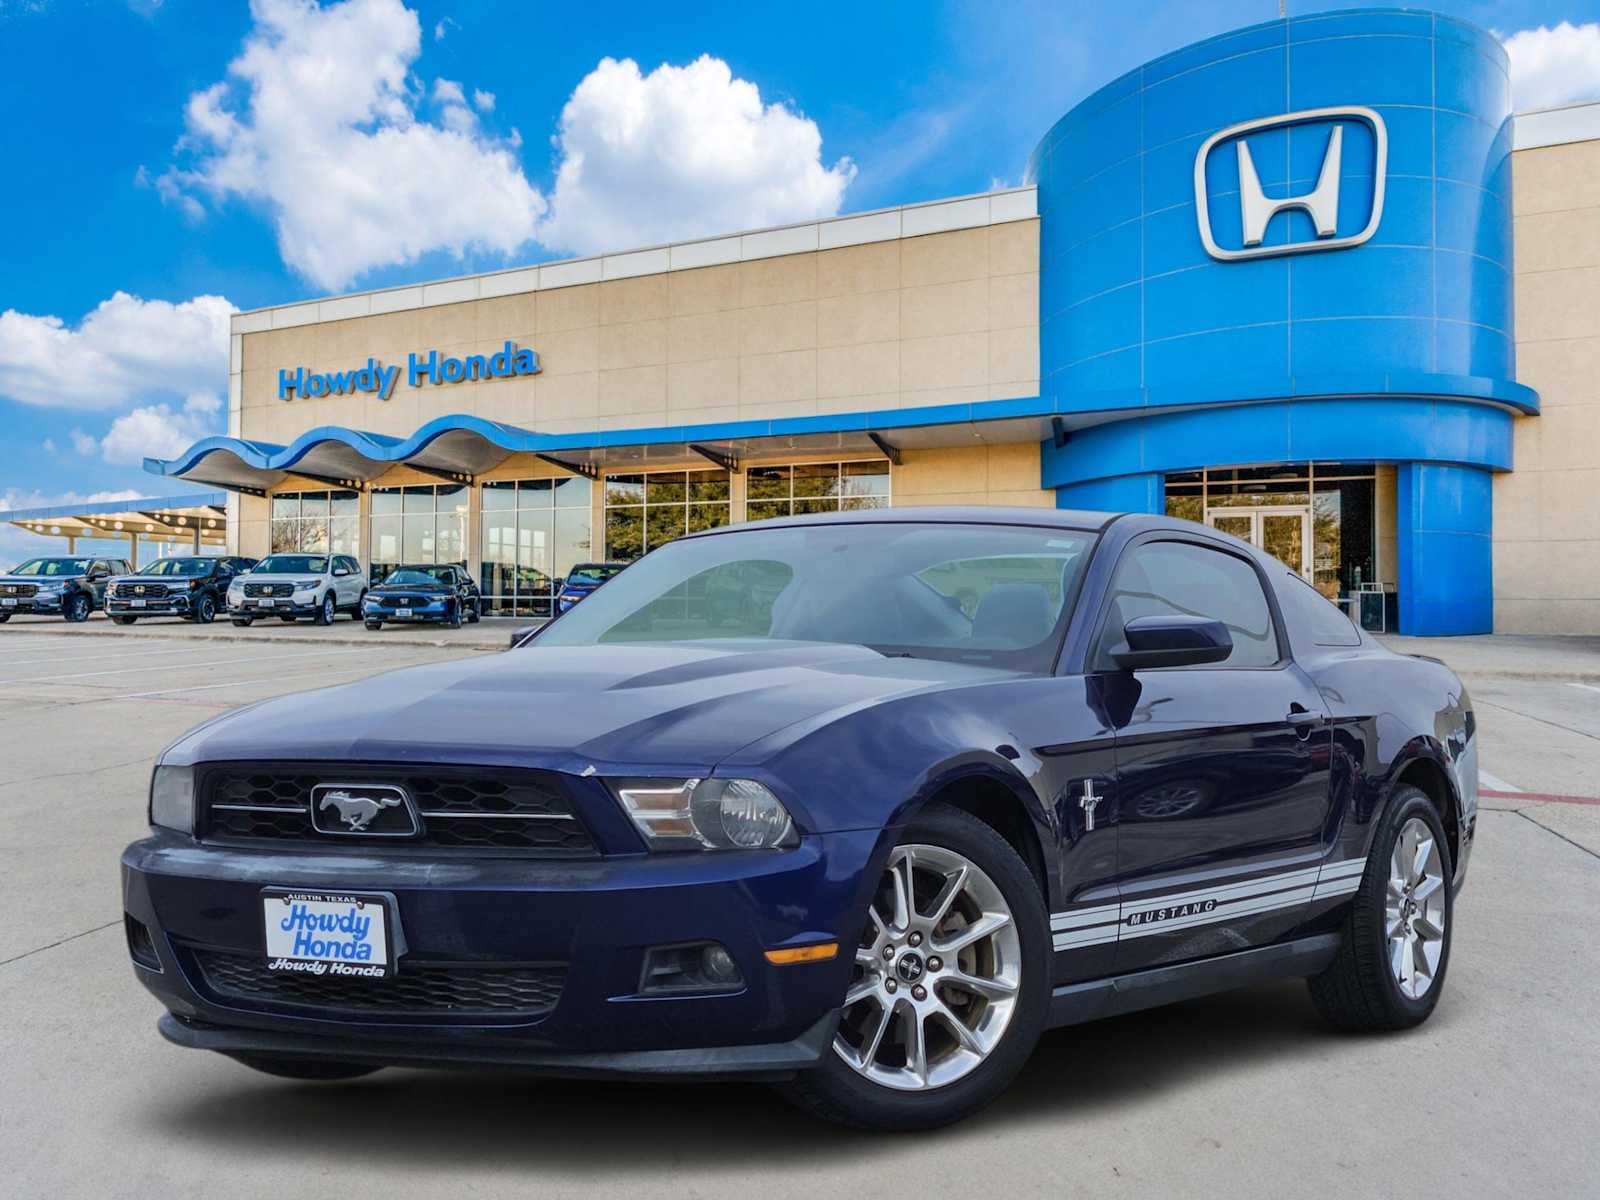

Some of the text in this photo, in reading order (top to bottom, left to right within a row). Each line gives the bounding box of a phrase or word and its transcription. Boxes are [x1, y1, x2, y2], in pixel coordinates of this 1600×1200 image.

[278, 340, 542, 401] Howdy Honda
[288, 893, 357, 904] AUSTIN TEXAS
[281, 904, 370, 941] Howdy
[1130, 901, 1213, 925] MUSTANG
[292, 930, 372, 961] Honda
[268, 958, 386, 978] Howdy Honda
